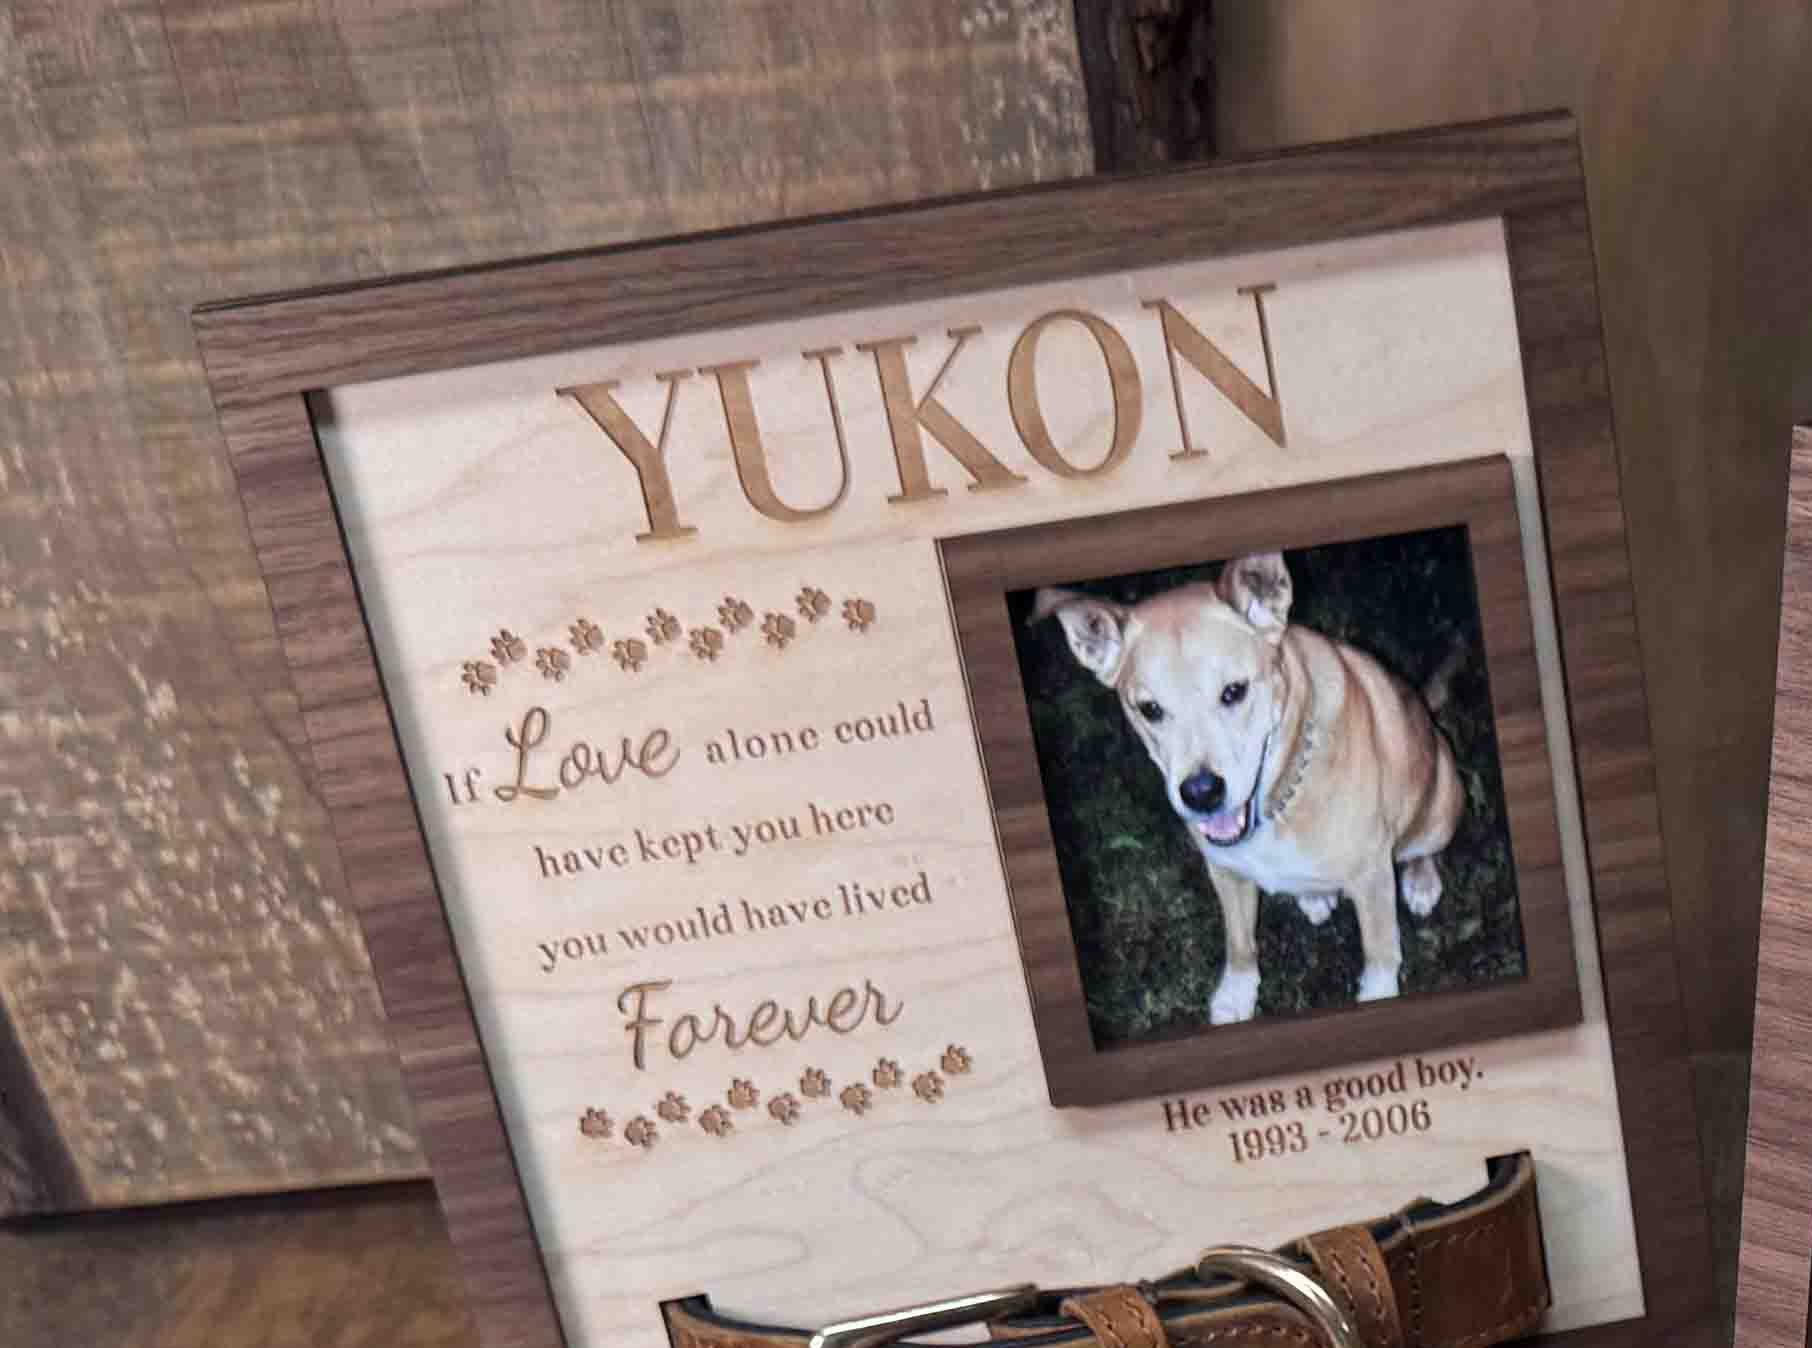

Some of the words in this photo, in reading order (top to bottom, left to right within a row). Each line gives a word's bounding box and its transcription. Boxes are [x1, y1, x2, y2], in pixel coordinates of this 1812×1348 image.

[555, 283, 1287, 541] YUKON
[444, 768, 481, 805] If
[493, 706, 681, 801] Love
[706, 722, 820, 766] alone
[834, 700, 935, 745] could
[533, 843, 631, 879] have
[637, 822, 723, 868] kept
[731, 814, 802, 857] you
[807, 800, 896, 837] here
[538, 932, 608, 972] you
[618, 903, 735, 952] would
[742, 896, 833, 933] have
[839, 872, 933, 918] lived
[617, 979, 904, 1071] Forever
[1161, 1101, 1212, 1132] He
[1219, 1090, 1286, 1122] was
[1296, 1086, 1314, 1110] a
[1324, 1063, 1407, 1113] good
[1416, 1056, 1484, 1090] boy.
[1228, 1122, 1309, 1164] 1993
[1339, 1100, 1433, 1143] 2006
